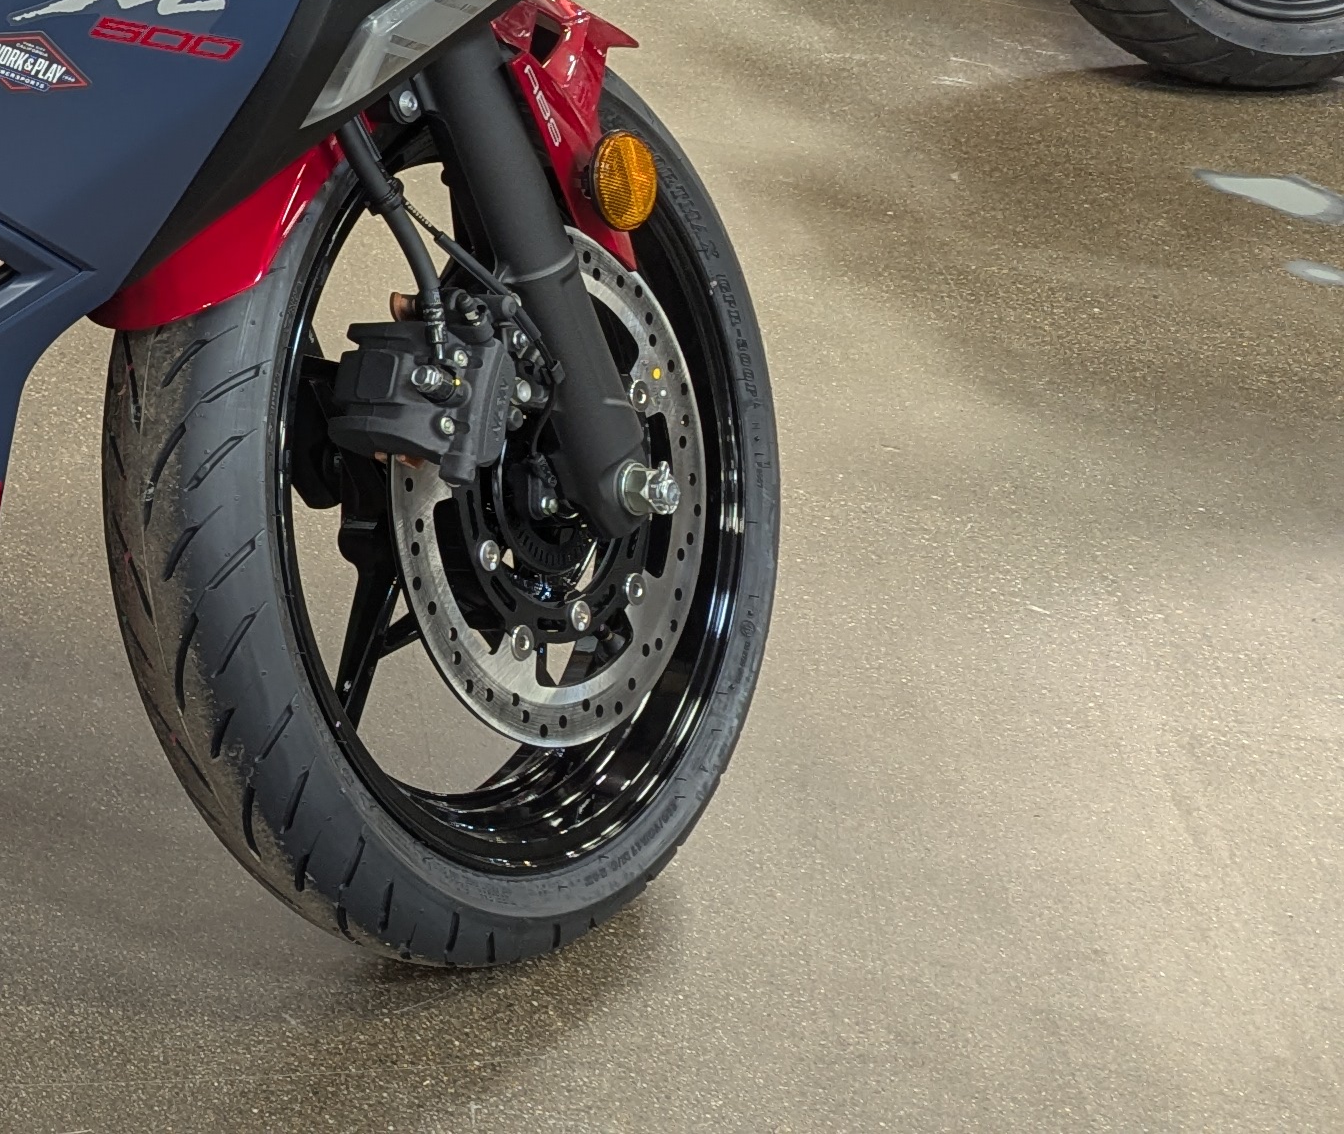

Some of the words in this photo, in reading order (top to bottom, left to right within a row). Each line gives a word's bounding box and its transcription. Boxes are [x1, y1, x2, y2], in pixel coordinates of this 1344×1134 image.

[16, 43, 49, 57] CALIFORNIA
[88, 16, 243, 61] 500
[524, 65, 562, 147] ABS
